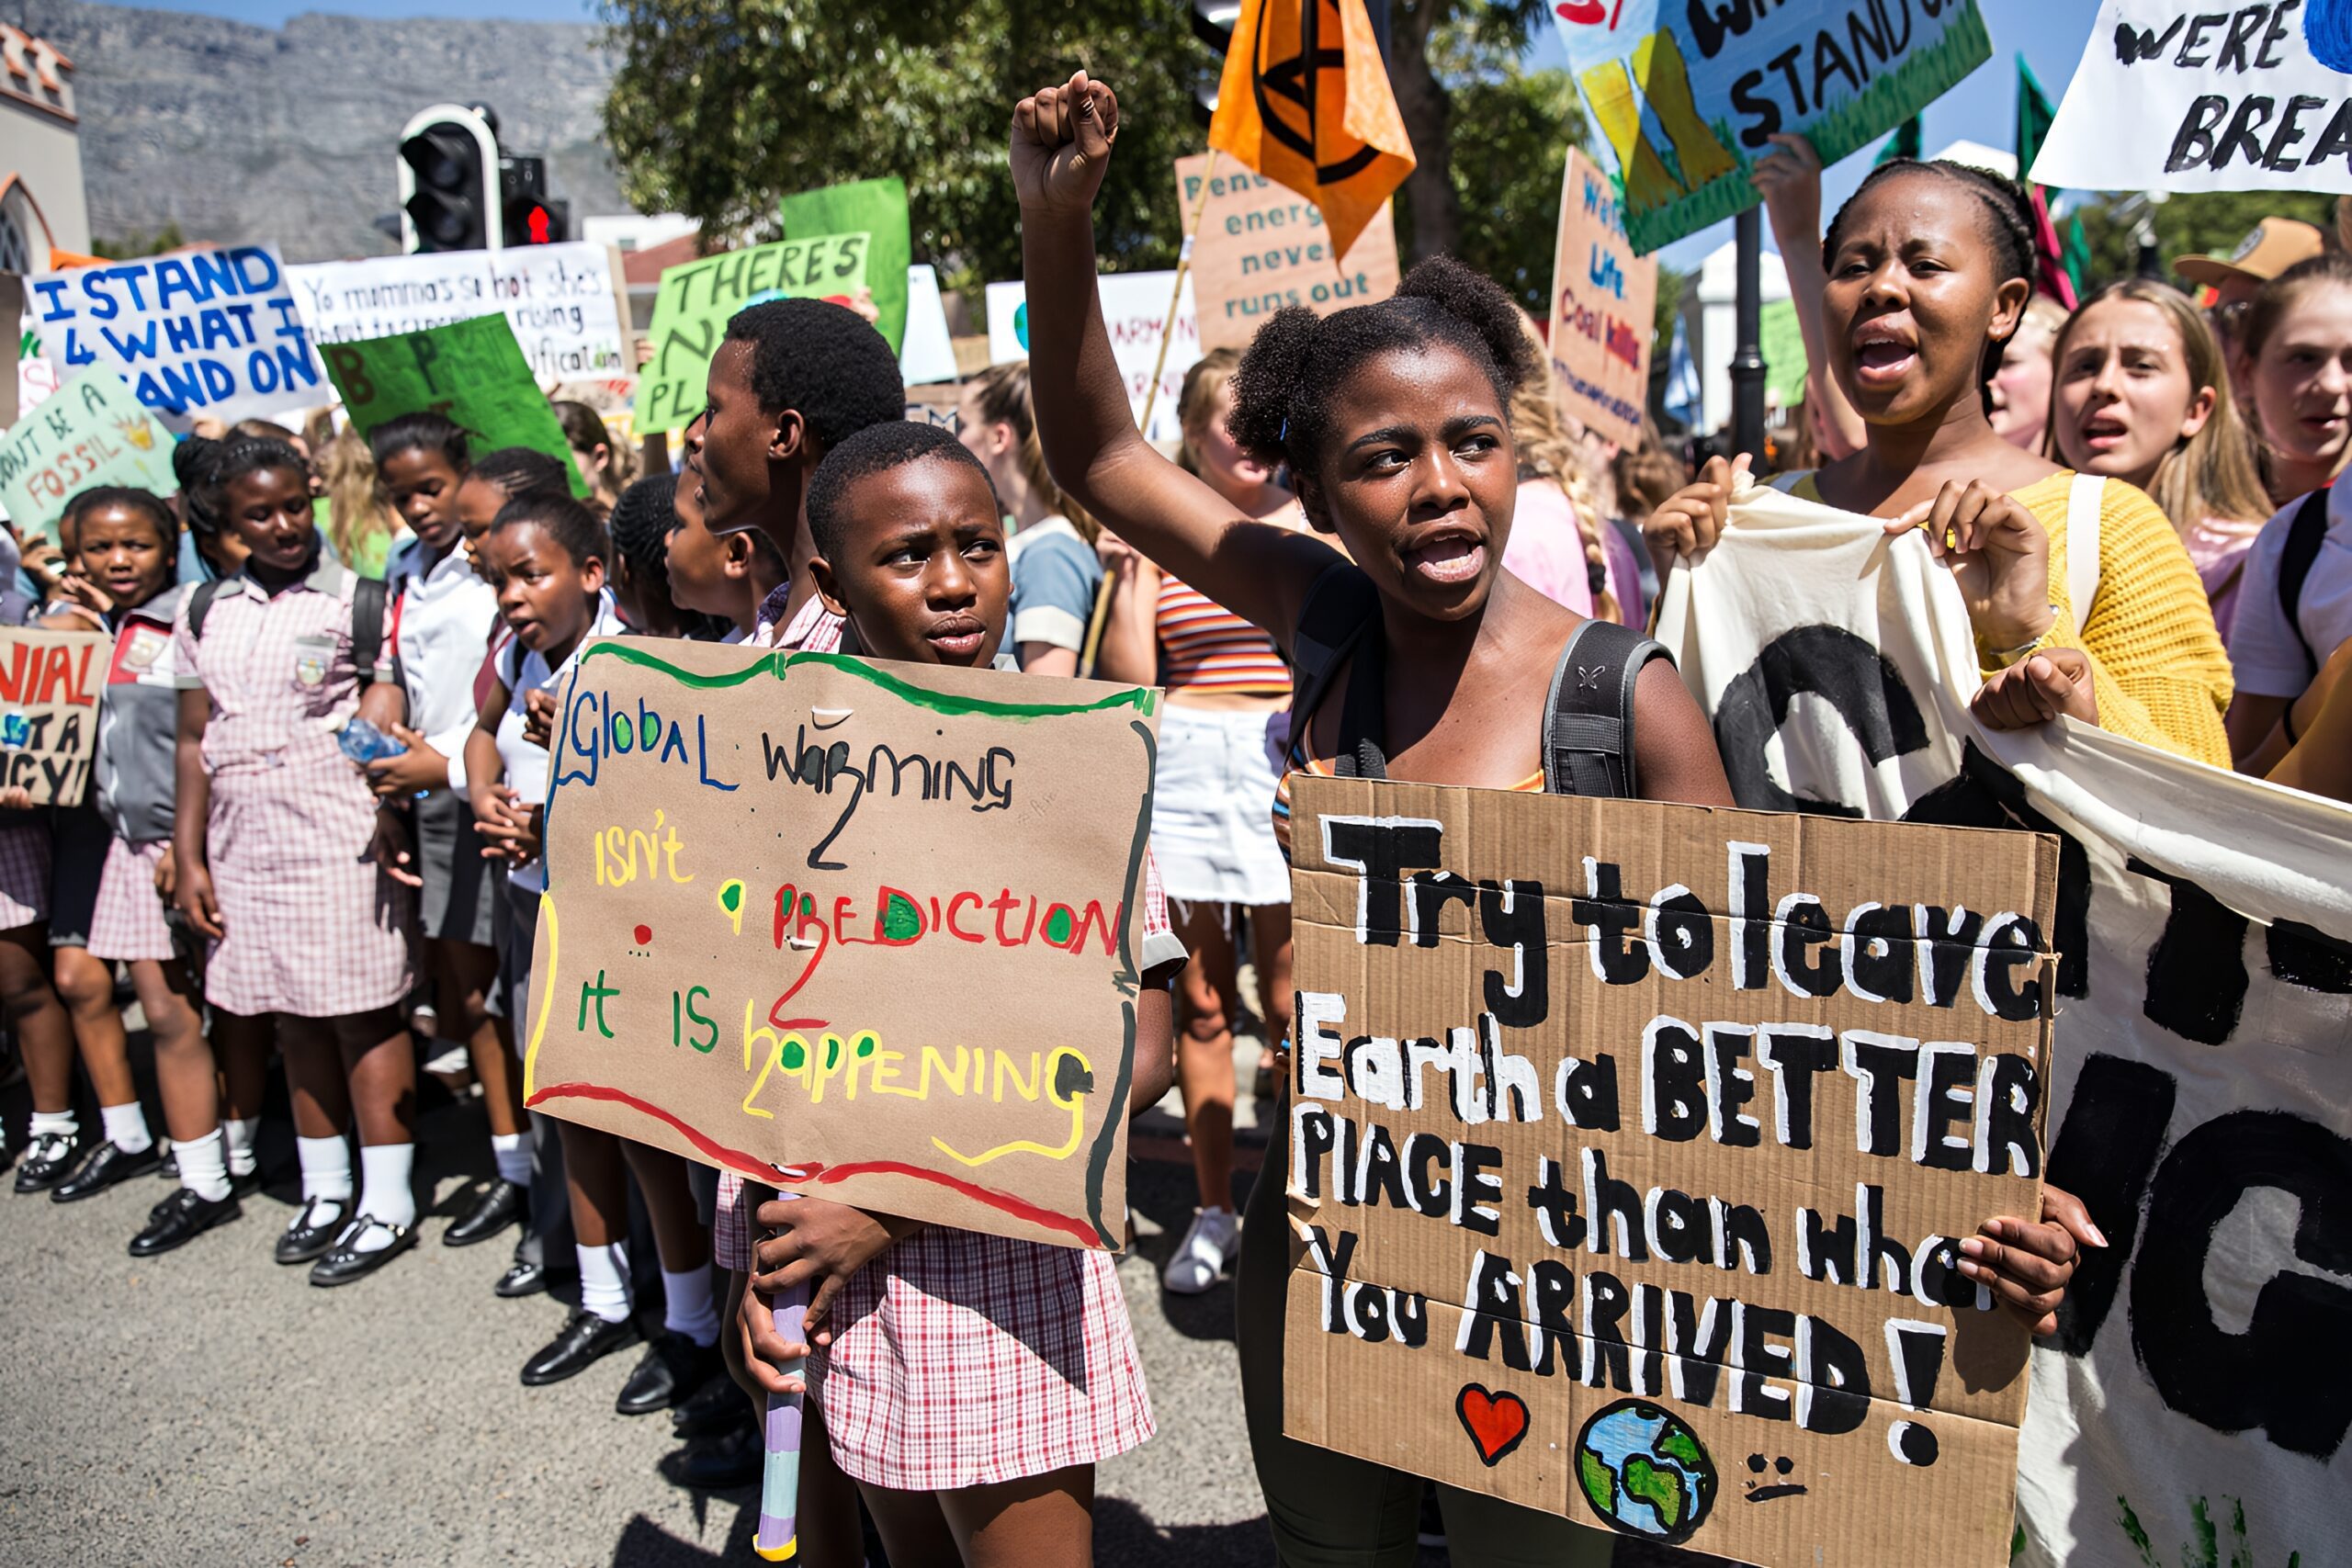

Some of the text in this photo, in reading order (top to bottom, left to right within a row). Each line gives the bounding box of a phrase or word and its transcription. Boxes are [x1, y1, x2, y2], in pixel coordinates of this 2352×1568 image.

[1731, 0, 1912, 148] STAND
[2114, 0, 2300, 74] WERE
[1225, 203, 1323, 235] energ
[33, 246, 279, 321] I STAND
[489, 260, 532, 299] hot
[1225, 272, 1369, 318] runs out
[1561, 287, 1602, 344] Coal
[65, 328, 96, 366] 4
[100, 304, 257, 364] WHAT
[266, 297, 307, 339] I
[661, 319, 715, 378] N
[120, 358, 236, 417] AND
[248, 332, 320, 393] ON
[45, 406, 74, 442] BE
[81, 382, 108, 418] A
[25, 434, 122, 510] FOSSIL
[54, 713, 81, 755] A
[1319, 815, 1549, 1028] Try
[1571, 854, 1714, 986] to
[1726, 840, 2043, 1022] leave
[1295, 990, 2042, 1179] Earth a BETTER
[1527, 1145, 1772, 1275] than
[1302, 1224, 1429, 1348] You
